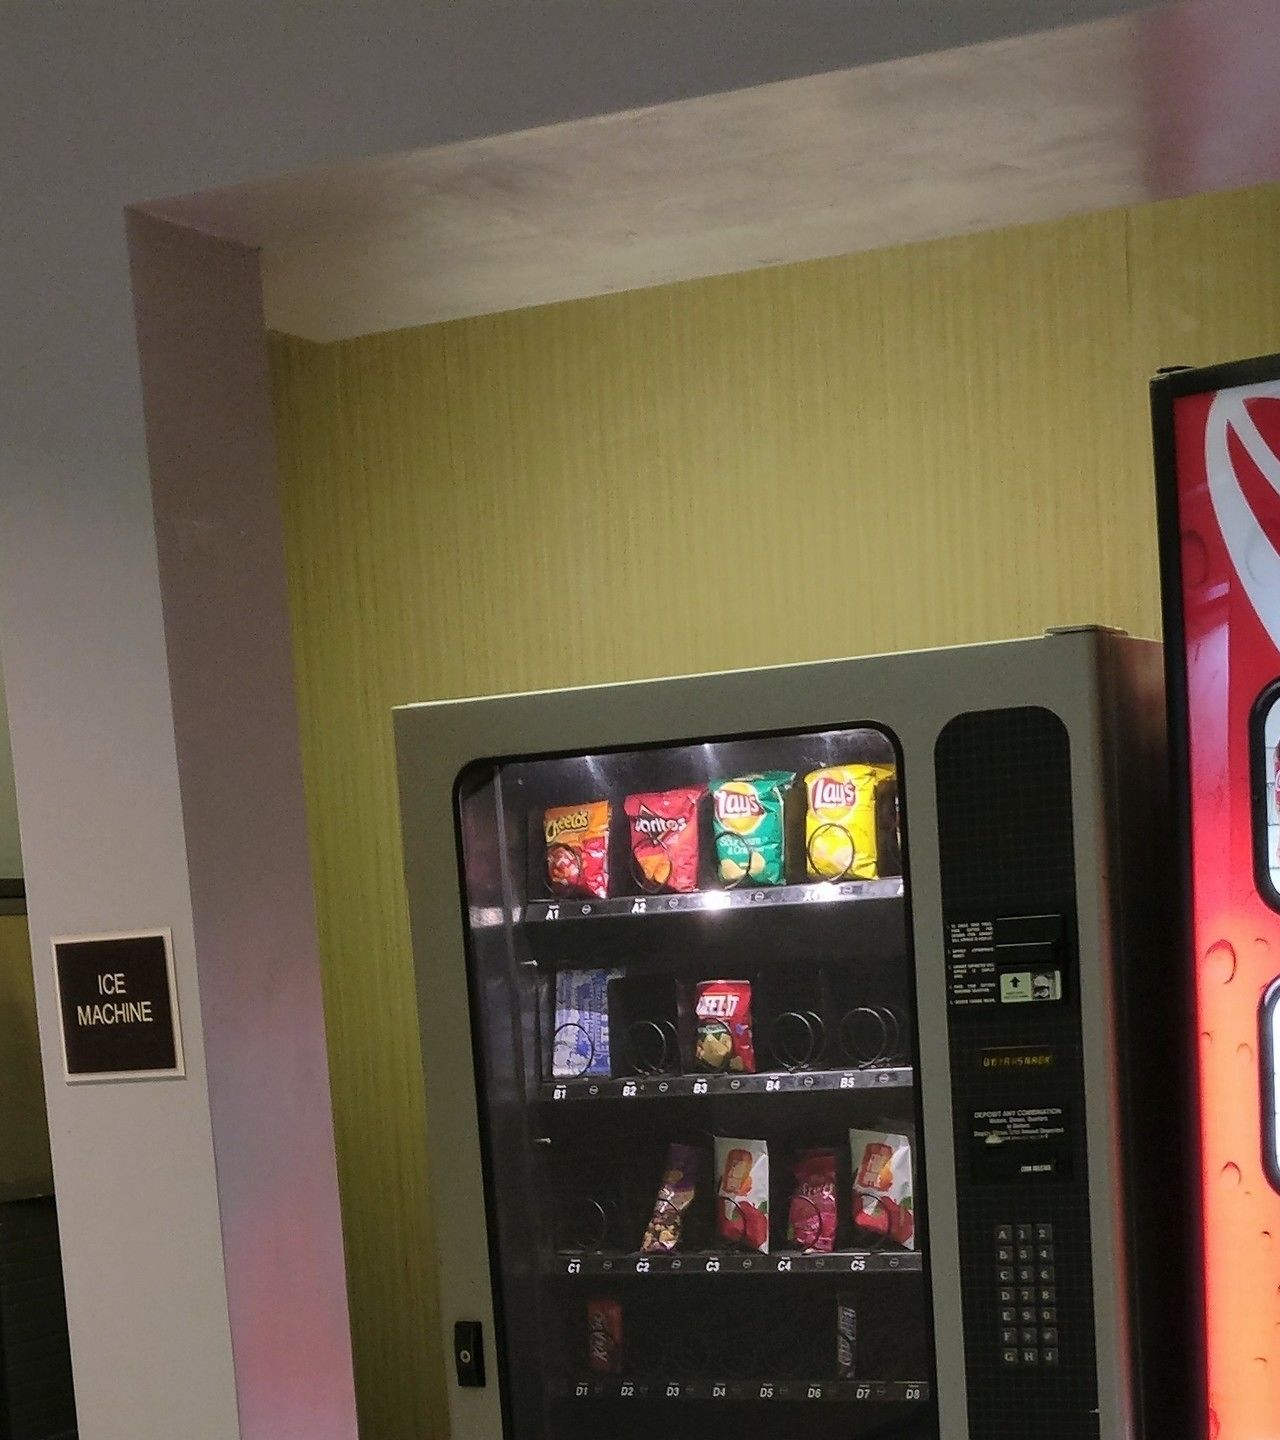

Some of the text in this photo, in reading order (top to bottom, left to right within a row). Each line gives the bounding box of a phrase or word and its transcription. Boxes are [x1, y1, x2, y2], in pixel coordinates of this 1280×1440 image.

[814, 777, 856, 808] Lay's
[714, 790, 759, 820] Lay's
[545, 909, 559, 921] A1
[631, 902, 647, 914] A2
[97, 972, 127, 996] ICE
[76, 1000, 154, 1026] MACHINE
[553, 1077, 855, 1100] B1 B2 B3 B4 B5
[567, 1259, 866, 1274] C1 C2 C3 C4 C5
[575, 1386, 920, 1399] D1 D2 D3 D4 D5 D6 D7 D8
